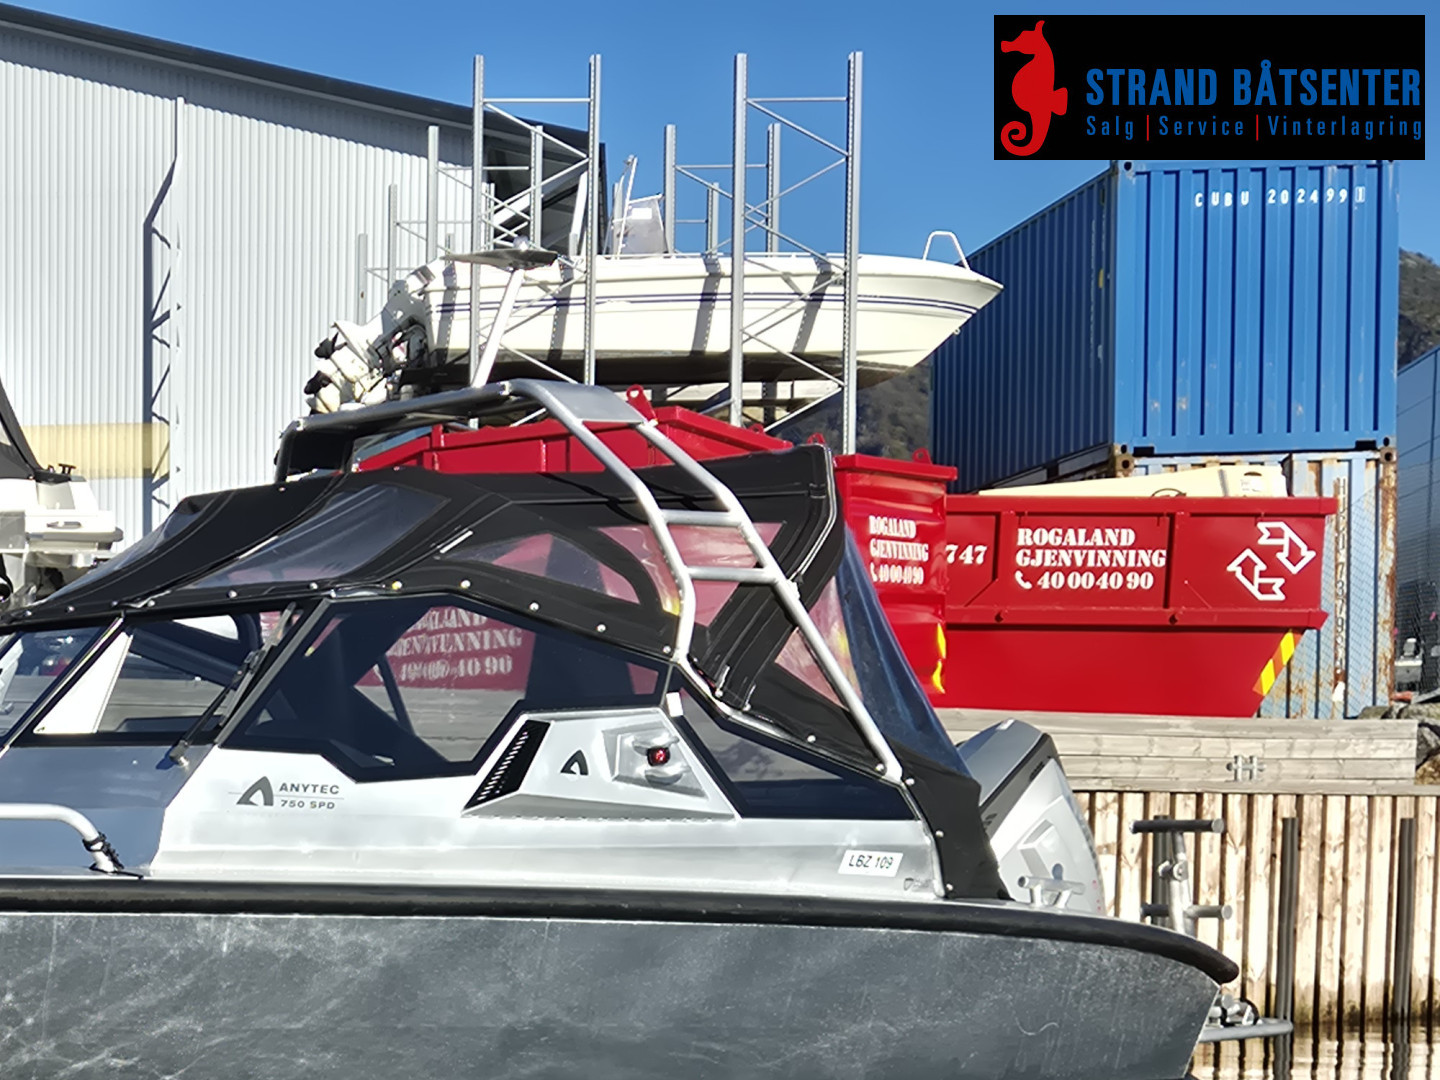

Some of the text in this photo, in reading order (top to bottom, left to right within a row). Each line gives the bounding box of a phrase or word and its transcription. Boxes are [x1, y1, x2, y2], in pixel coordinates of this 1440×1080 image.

[1194, 190, 1250, 207] CUBU
[1267, 187, 1348, 205] 202499
[868, 515, 917, 538] ROGALAND
[1016, 528, 1136, 546] ROGALAND
[869, 538, 929, 562] GJENVINNING
[945, 544, 988, 564] 747
[1015, 549, 1167, 567] GJENVINNING
[279, 782, 340, 795] ANYTEC
[280, 800, 336, 810] 750 SPD
[874, 856, 894, 869] 109
